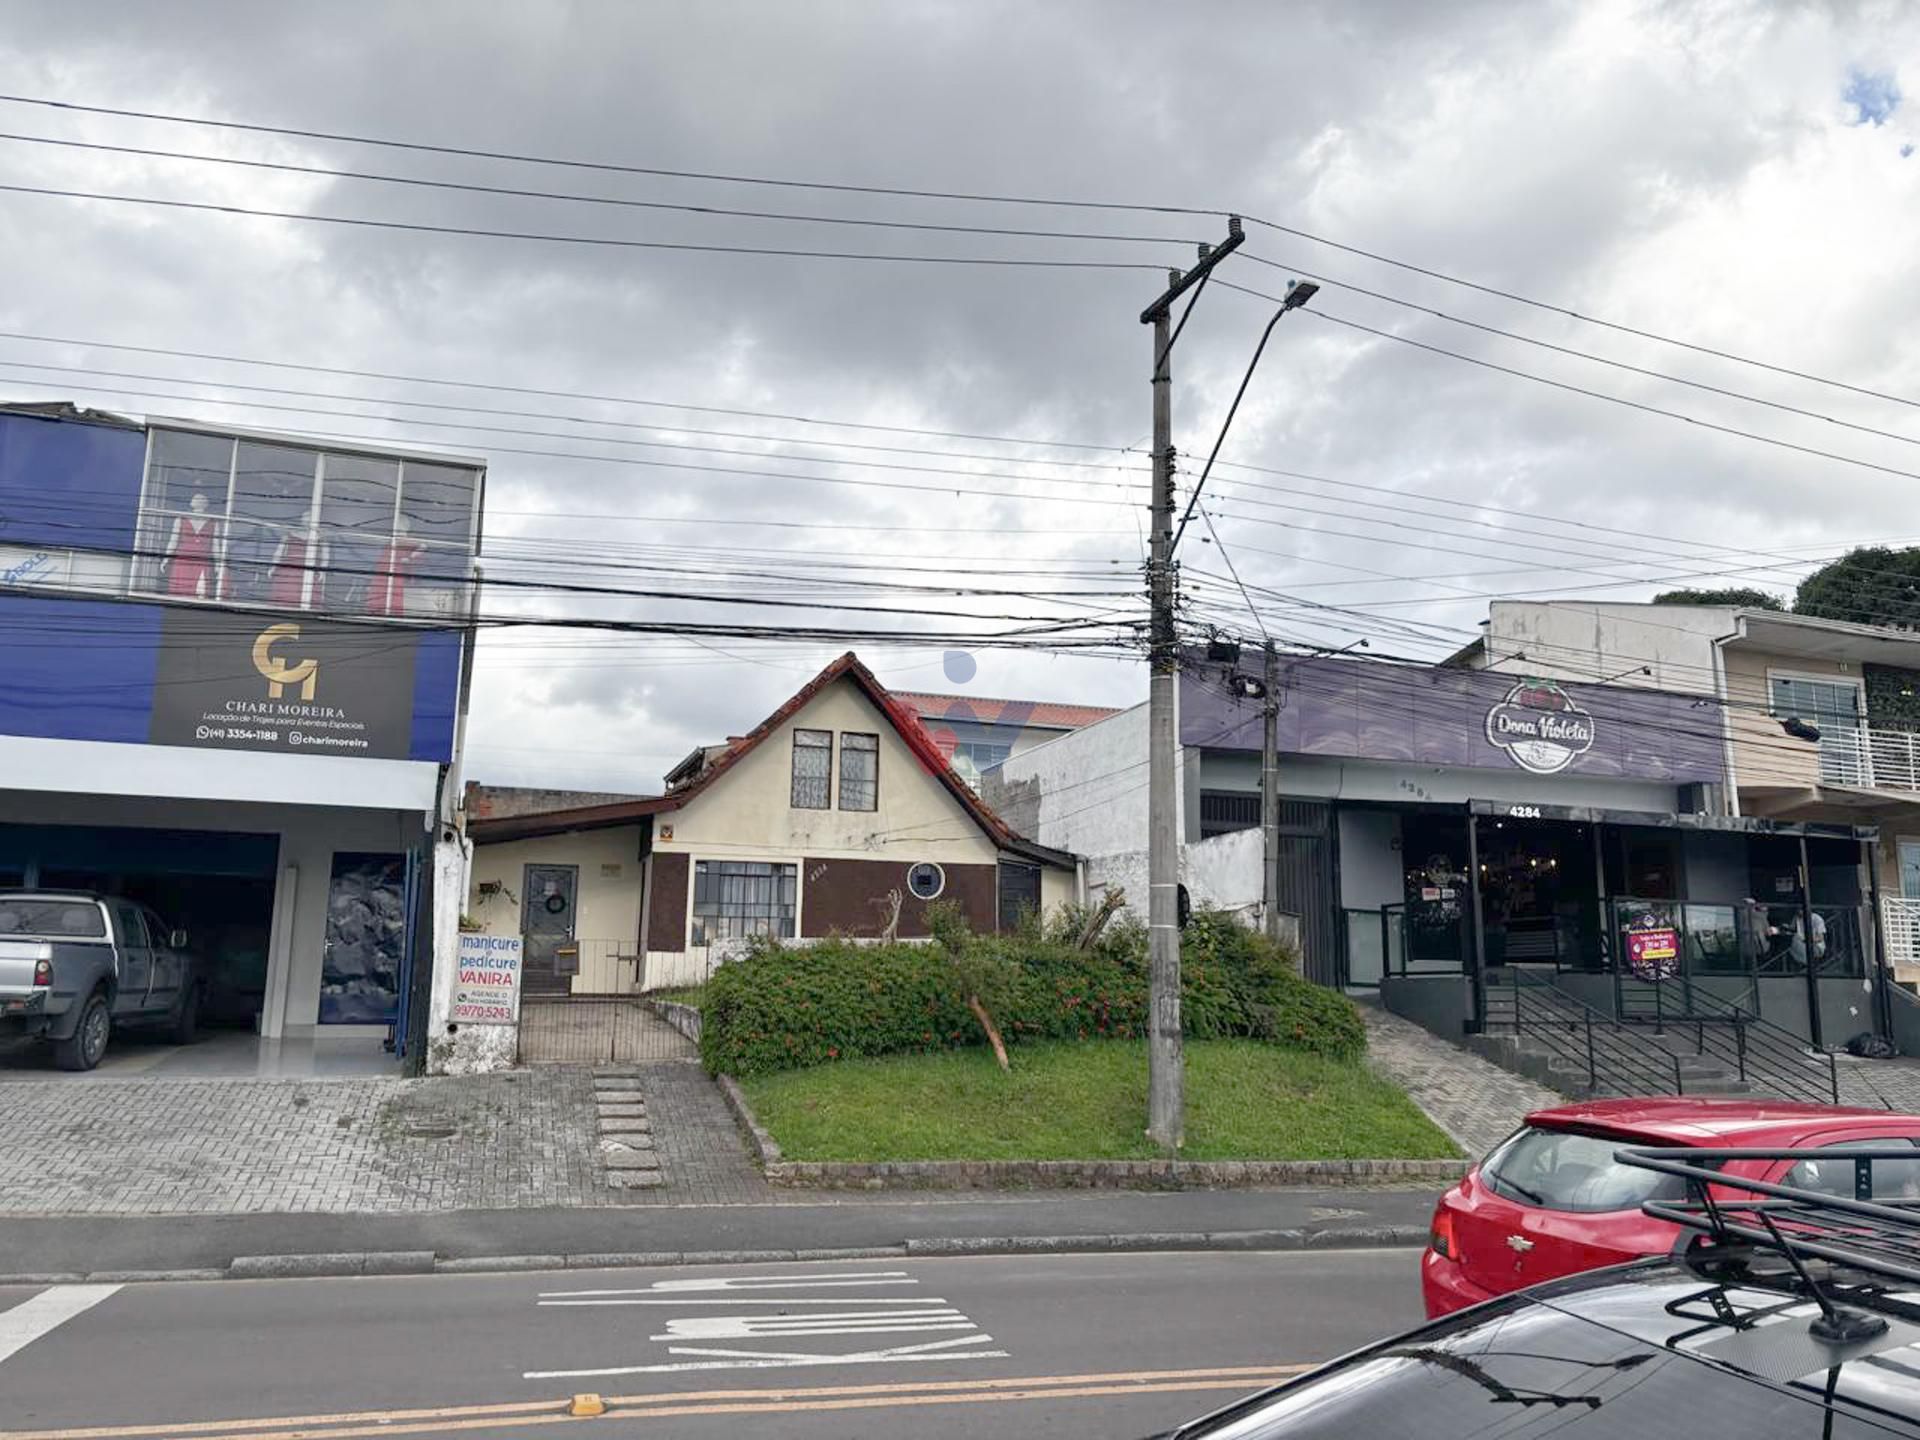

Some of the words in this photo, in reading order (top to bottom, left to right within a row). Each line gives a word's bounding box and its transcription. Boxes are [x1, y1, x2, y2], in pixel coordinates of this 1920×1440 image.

[226, 701, 273, 714] CHARI
[278, 705, 345, 718] MOREIRA
[276, 718, 296, 726] para
[297, 718, 327, 728] Eventos
[1499, 714, 1537, 735] Dona
[1538, 716, 1589, 740] Violeta
[209, 728, 225, 739] (41)
[227, 728, 278, 741] 3354-1188
[303, 736, 368, 748] charimoreira
[1509, 806, 1541, 818] 4284
[462, 936, 519, 951] manicure
[460, 956, 517, 970] pedicure
[459, 970, 513, 986] VANIRA
